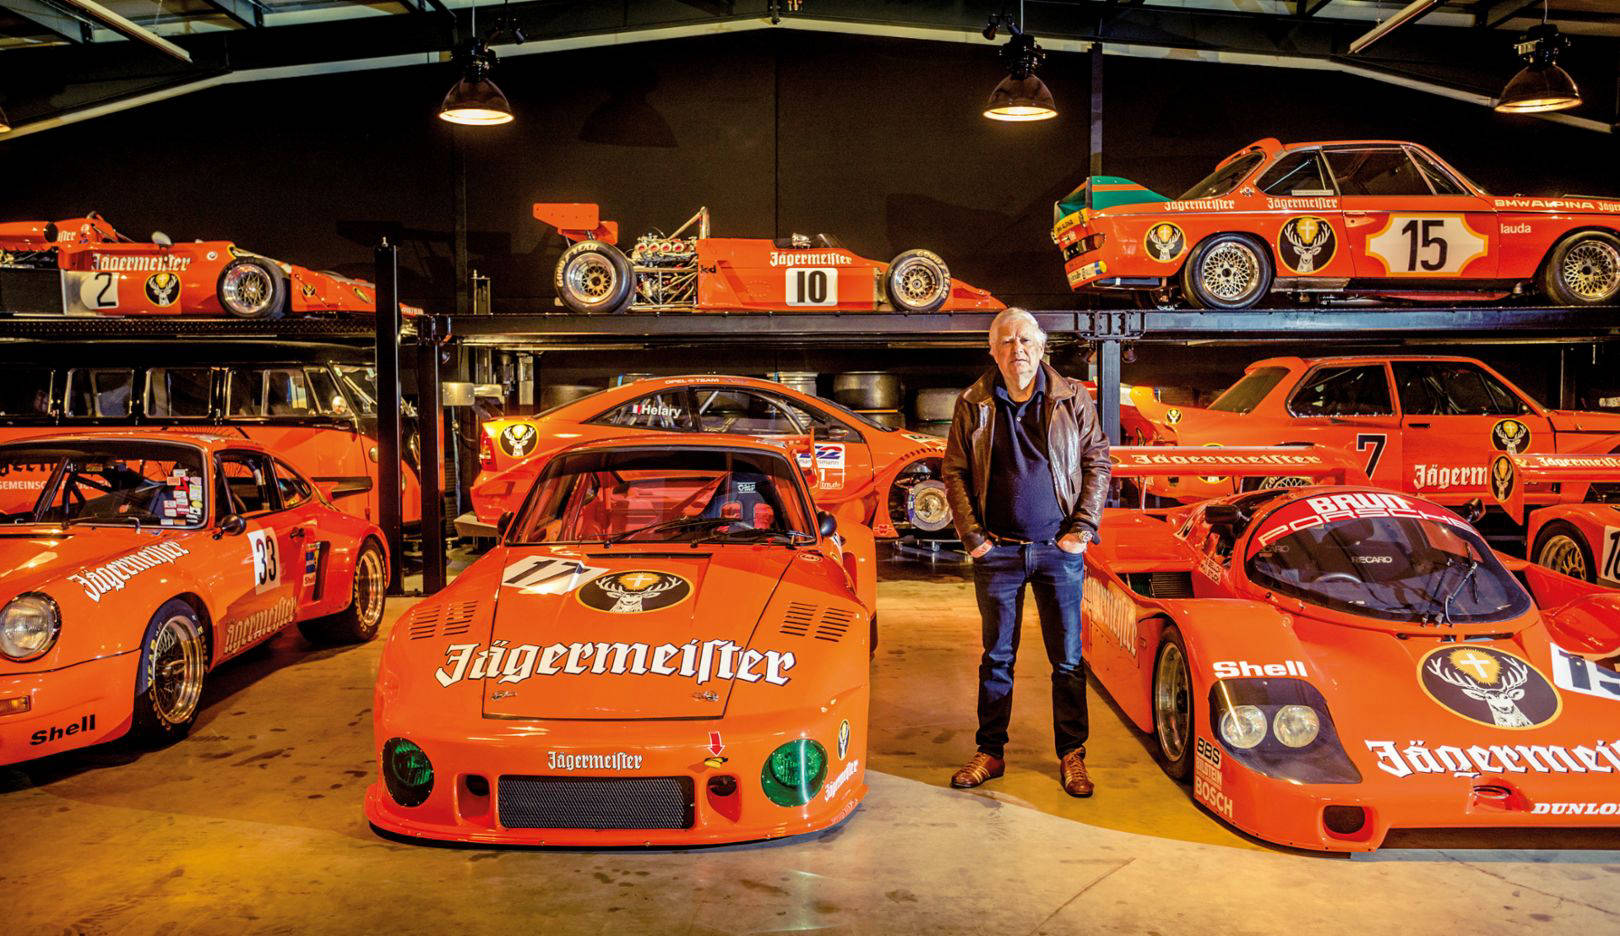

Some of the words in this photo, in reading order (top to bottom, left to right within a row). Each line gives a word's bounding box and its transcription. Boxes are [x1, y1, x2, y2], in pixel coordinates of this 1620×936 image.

[1500, 223, 1532, 234] lauda
[769, 251, 852, 267] Jägermeister
[1401, 220, 1448, 272] 15
[94, 273, 117, 307] 2
[795, 270, 827, 303] 10
[640, 406, 681, 419] Helary
[1130, 454, 1323, 466] Jägermeister
[1356, 433, 1387, 480] 7
[1306, 494, 1410, 515] BRUN
[1256, 507, 1482, 548] PORSCHE
[66, 541, 189, 603] Jägermeister
[256, 536, 276, 585] 33
[435, 639, 795, 688] Jägermeister
[1213, 660, 1308, 678] Shell
[30, 714, 96, 746] Shell
[548, 752, 643, 771] Jägermeister
[1197, 737, 1220, 766] BBS
[1196, 778, 1232, 818] BOSCH
